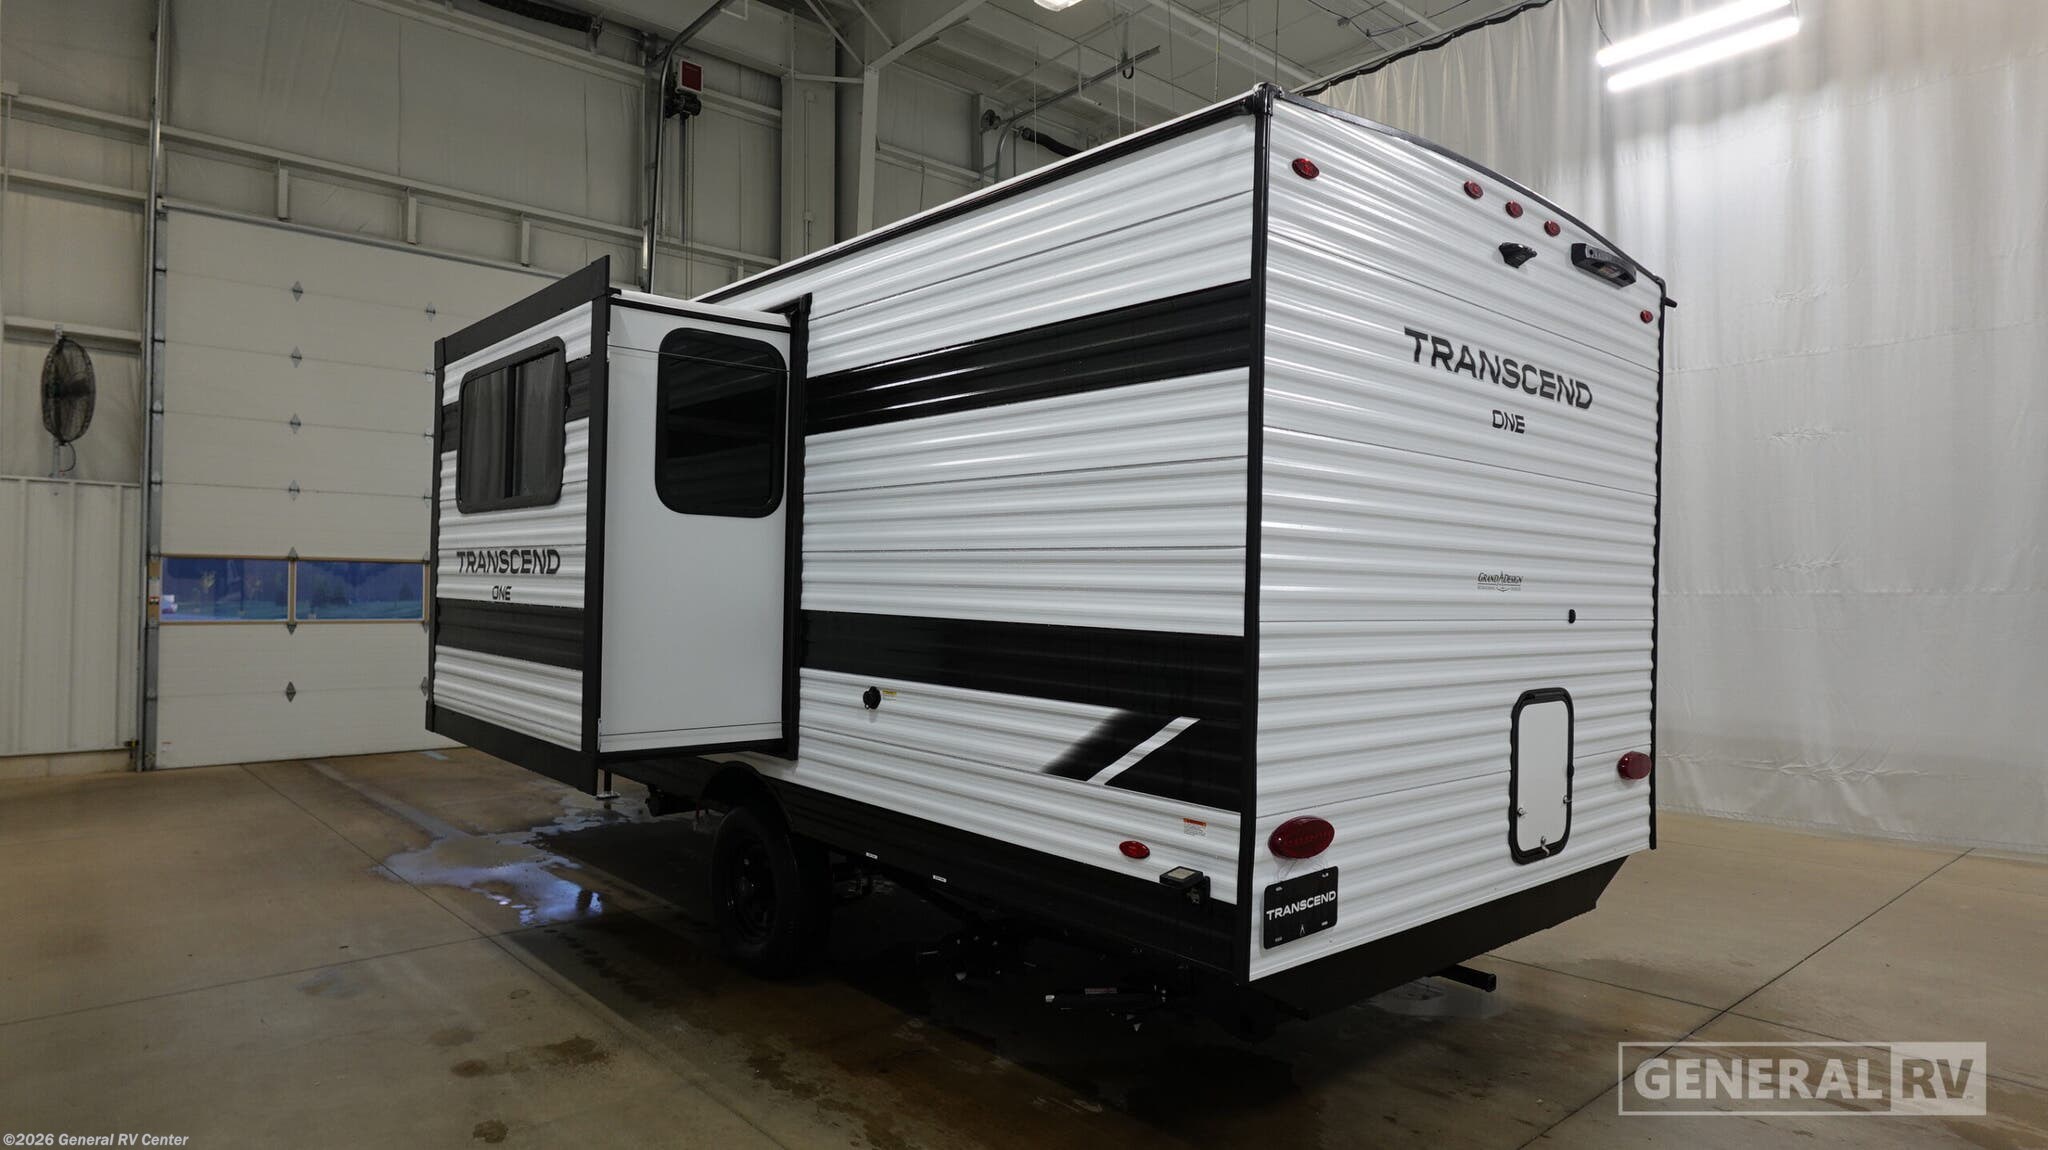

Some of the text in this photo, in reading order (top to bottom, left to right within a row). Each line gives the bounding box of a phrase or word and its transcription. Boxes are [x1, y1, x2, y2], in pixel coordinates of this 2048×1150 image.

[1404, 326, 1593, 410] TRANSCEND
[456, 549, 561, 575] TRANSCEND
[492, 585, 512, 601] ONE
[1266, 890, 1337, 921] TRANSCEND
